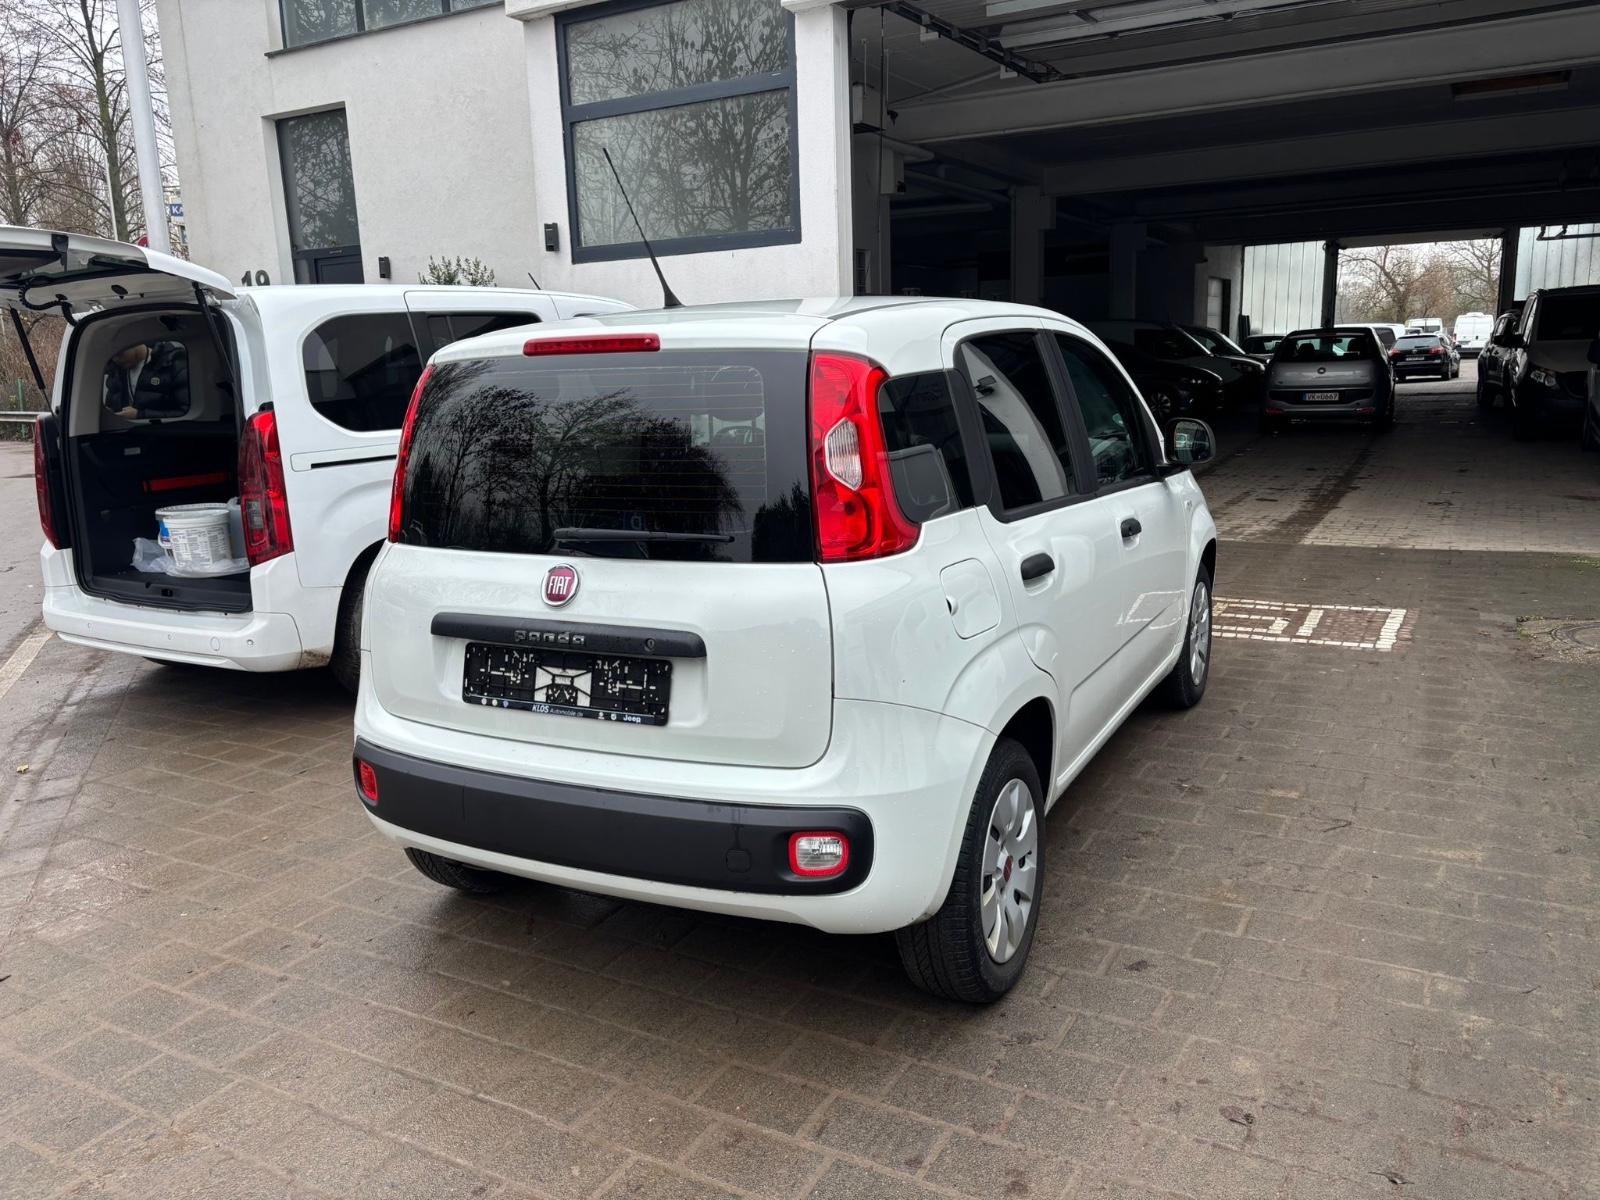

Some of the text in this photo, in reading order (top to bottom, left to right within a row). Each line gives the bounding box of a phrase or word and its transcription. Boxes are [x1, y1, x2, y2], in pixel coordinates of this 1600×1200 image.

[547, 575, 572, 595] FIAT
[514, 630, 585, 644] Panda
[532, 704, 549, 713] KLOS
[623, 714, 641, 723] Jeep
